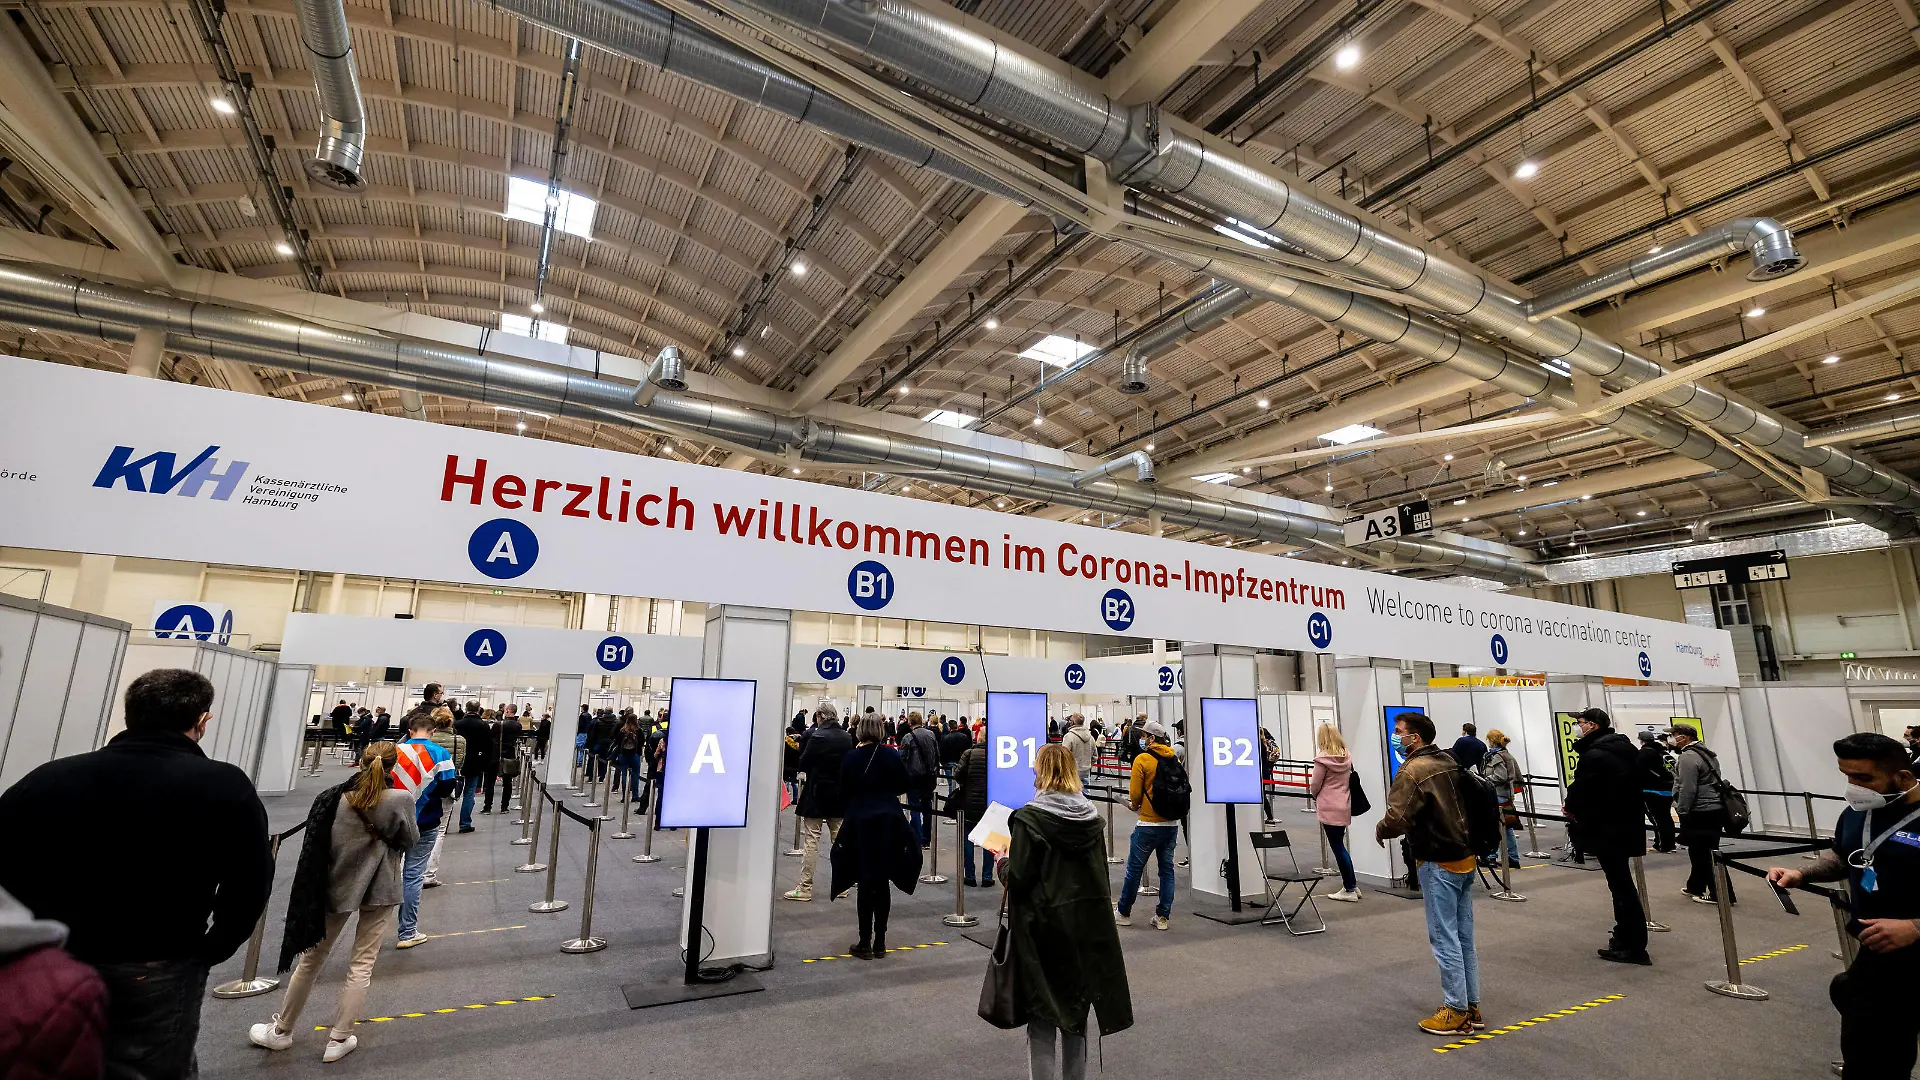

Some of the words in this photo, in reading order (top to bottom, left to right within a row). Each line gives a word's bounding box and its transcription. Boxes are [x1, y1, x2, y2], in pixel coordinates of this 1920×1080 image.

[0, 468, 37, 482] örde
[93, 445, 250, 501] KVH
[249, 485, 319, 503] Vereinigung
[254, 475, 348, 494] Kassenärztliche
[242, 495, 299, 511] Hamburg
[440, 454, 695, 531] Herzlich
[713, 499, 990, 567] willkommen
[1003, 533, 1046, 573] im
[1057, 542, 1346, 610] Corona-Impfzentrum
[1365, 515, 1398, 541] A3
[486, 531, 519, 565] A
[855, 570, 887, 600] B1
[1105, 597, 1131, 623] B2
[1366, 586, 1453, 624] Welcome
[1458, 603, 1474, 627] to
[1480, 611, 1532, 634] corona
[1536, 616, 1612, 644] vaccination
[1615, 629, 1652, 649] center
[1310, 619, 1328, 640] C1
[475, 638, 494, 657] A
[603, 644, 627, 663] B1
[1495, 640, 1503, 658] D
[821, 656, 841, 673] C1
[948, 663, 958, 678] D
[1640, 656, 1651, 672] C2
[1068, 669, 1083, 684] C2
[1158, 671, 1173, 687] C2
[688, 733, 726, 775] A
[996, 735, 1036, 769] B1
[1212, 736, 1254, 766] B2
[1896, 830, 1920, 842] EL
